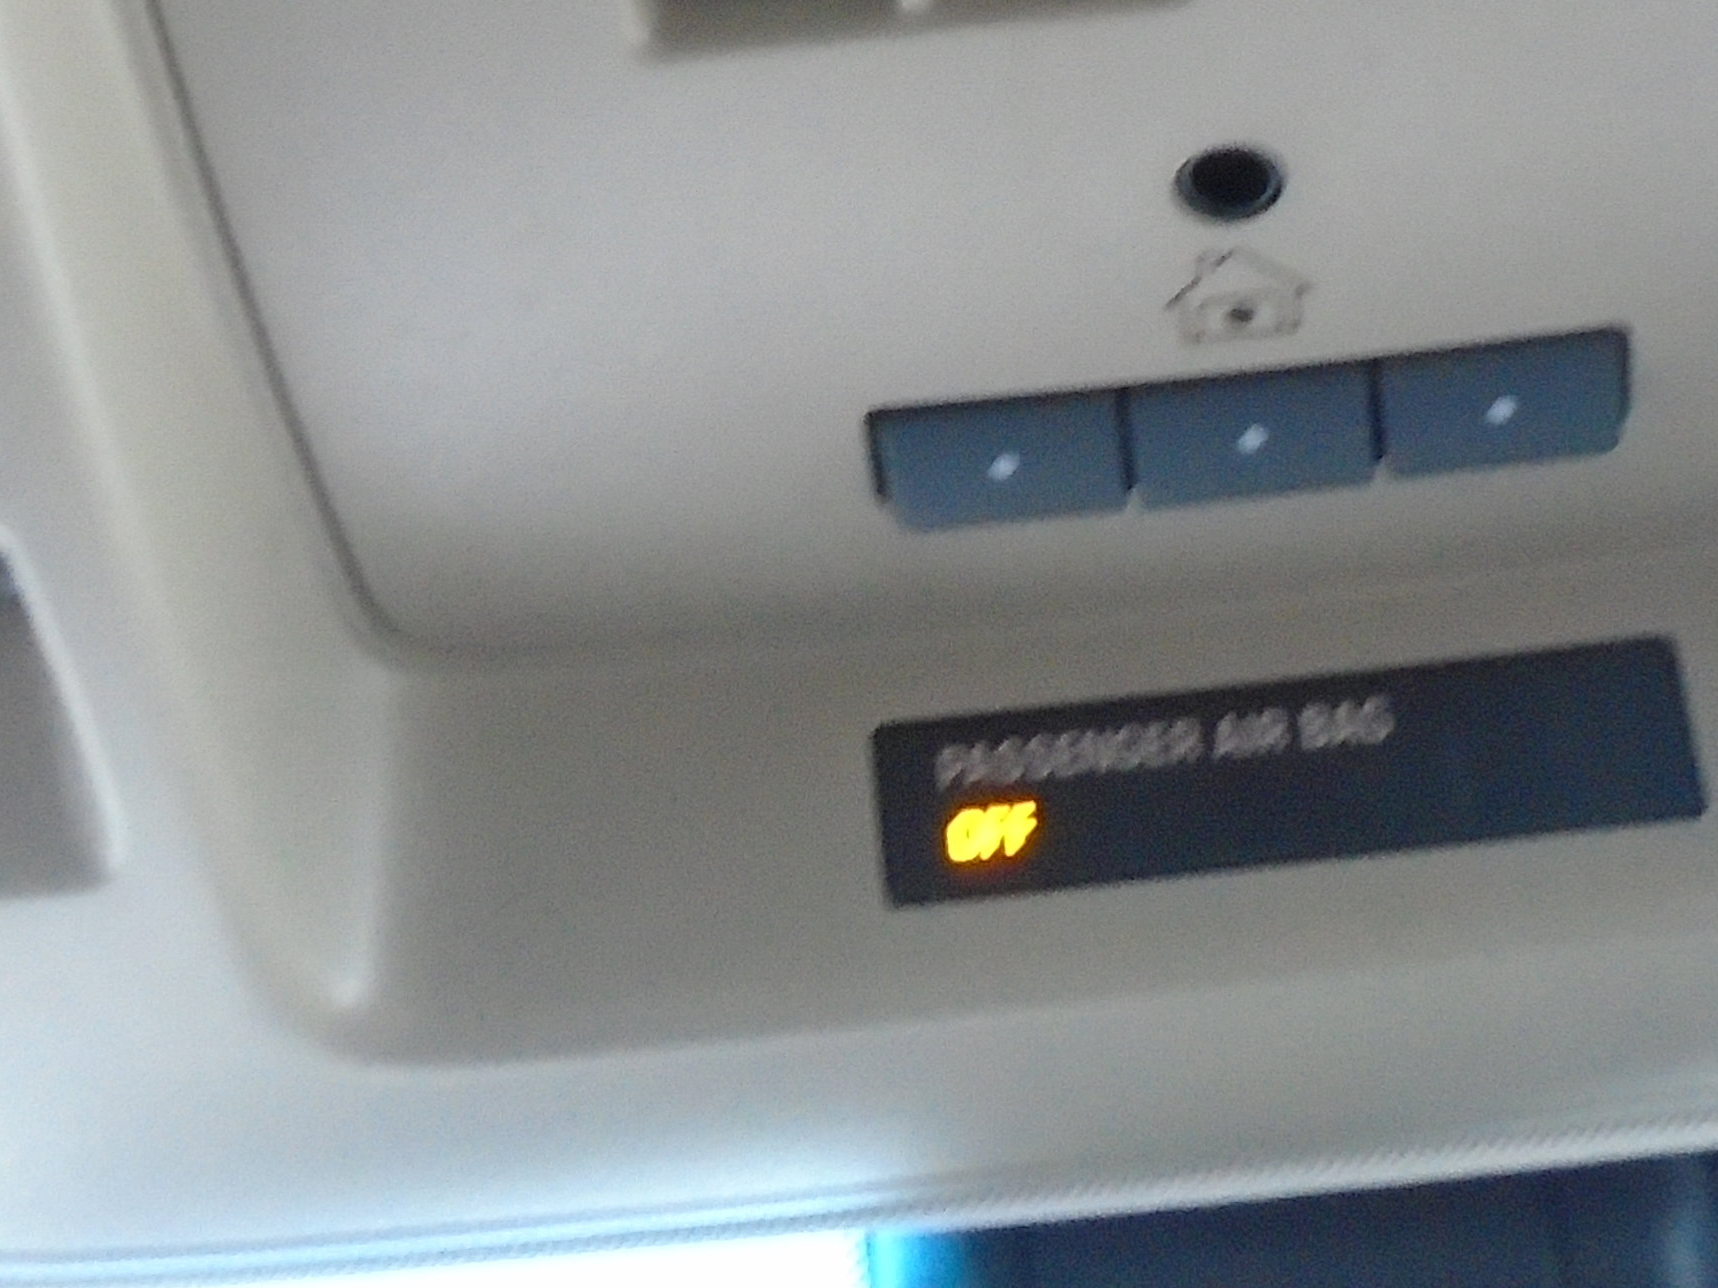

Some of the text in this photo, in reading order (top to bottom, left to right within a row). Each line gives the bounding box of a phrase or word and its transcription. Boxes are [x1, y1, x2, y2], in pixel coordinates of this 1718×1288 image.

[935, 693, 1395, 790] PASSENGER AIR BAG
[945, 800, 1038, 864] OFF
